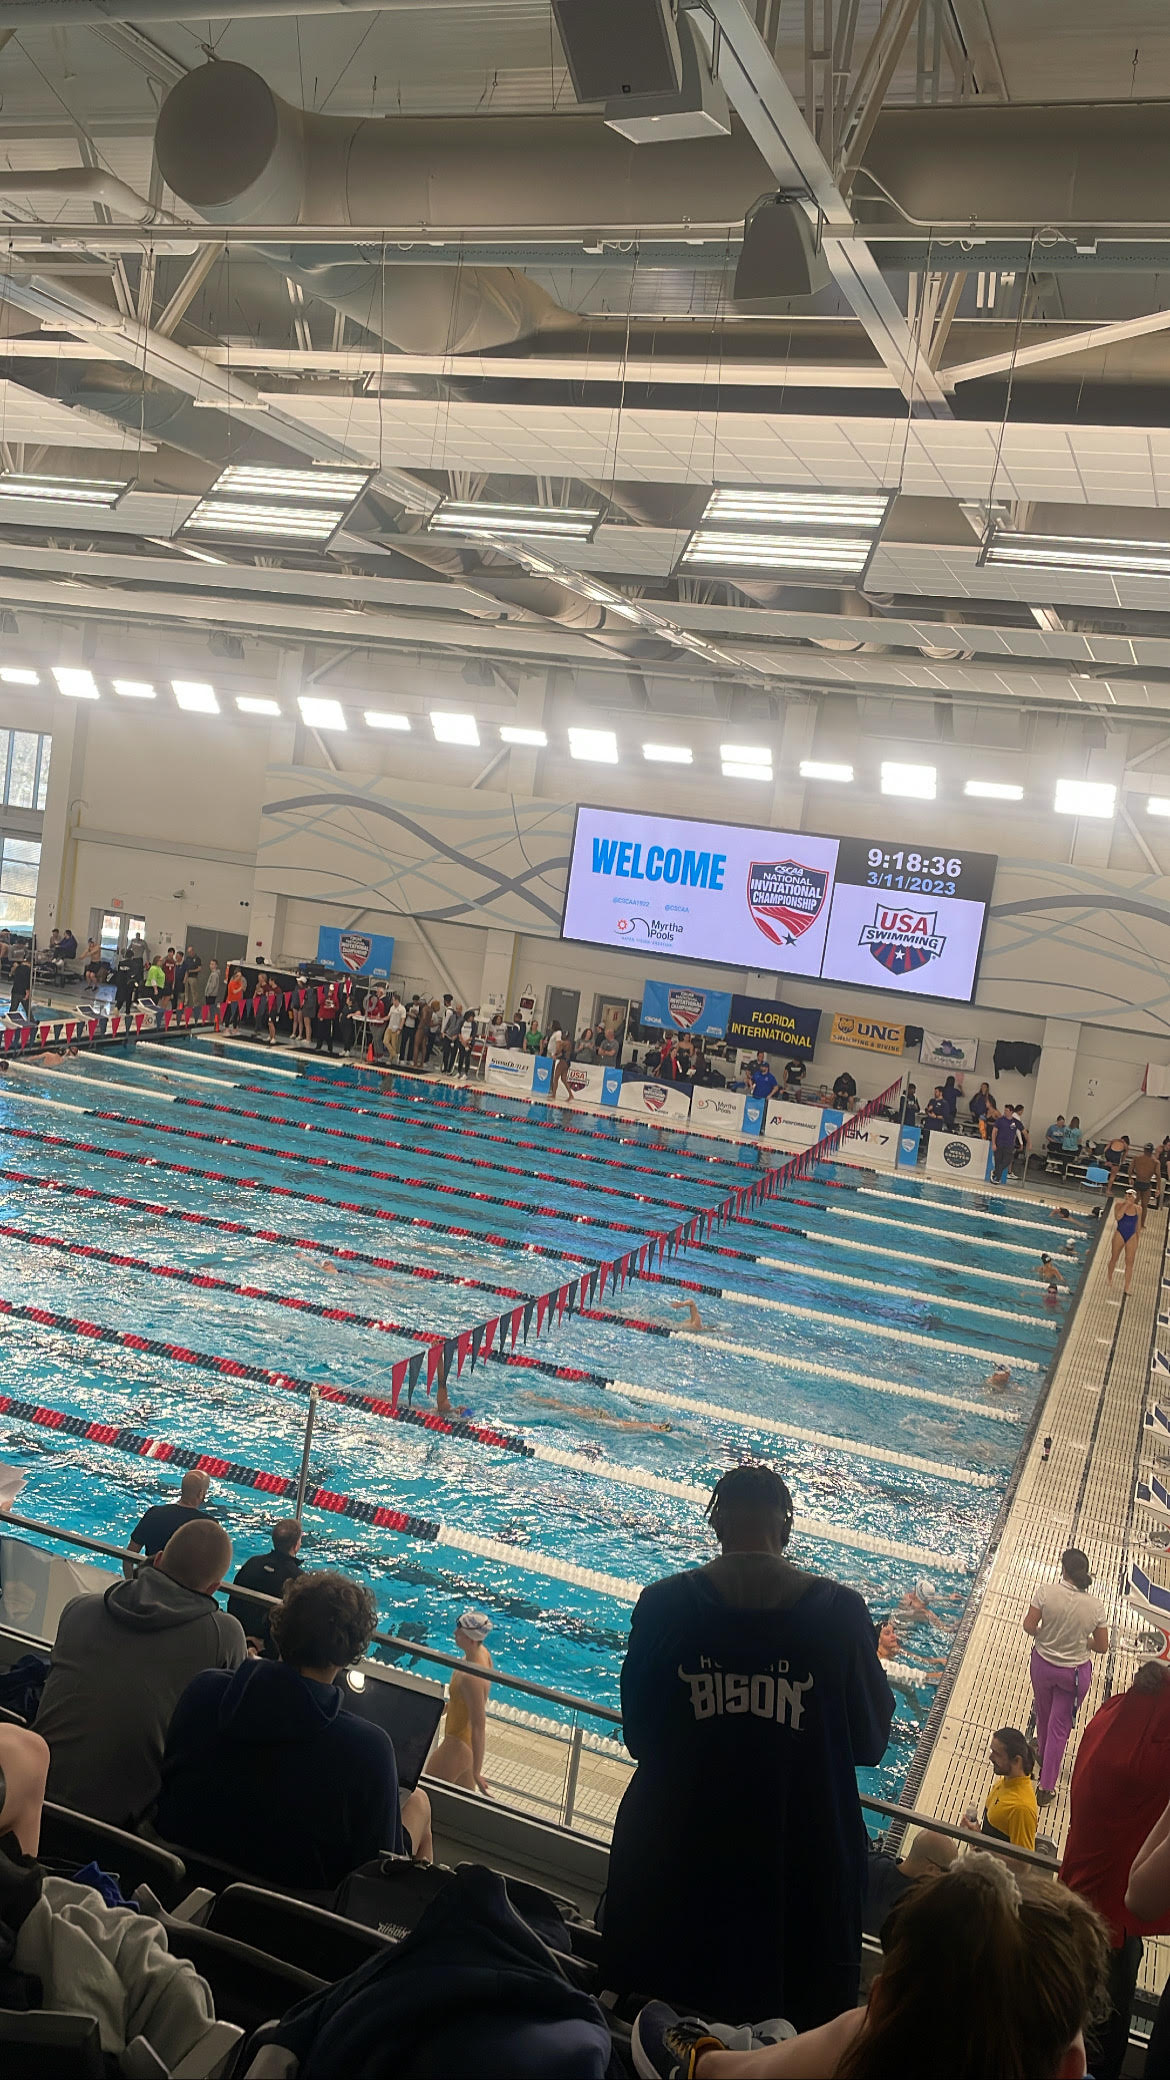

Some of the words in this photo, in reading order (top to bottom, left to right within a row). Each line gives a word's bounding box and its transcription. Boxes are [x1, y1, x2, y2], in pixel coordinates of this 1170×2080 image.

[592, 837, 727, 891] WELCOME
[775, 865, 804, 876] CSCAA
[867, 848, 962, 878] 9:18:36
[751, 879, 822, 899] INVITATIONAL
[763, 872, 812, 886] NATIONAL
[867, 871, 956, 895] 3/11/2023
[752, 891, 817, 911] CHAMPIONSHIP
[651, 919, 684, 933] Myrtha
[880, 911, 928, 936] USA
[650, 929, 674, 941] Pools
[866, 929, 939, 949] SWIMMING
[751, 1011, 796, 1030] FLORIDA
[731, 1021, 812, 1048] INTERNATIONAL
[857, 1023, 900, 1041] UNC
[570, 1070, 585, 1080] USA
[678, 1663, 814, 1730] BISON
